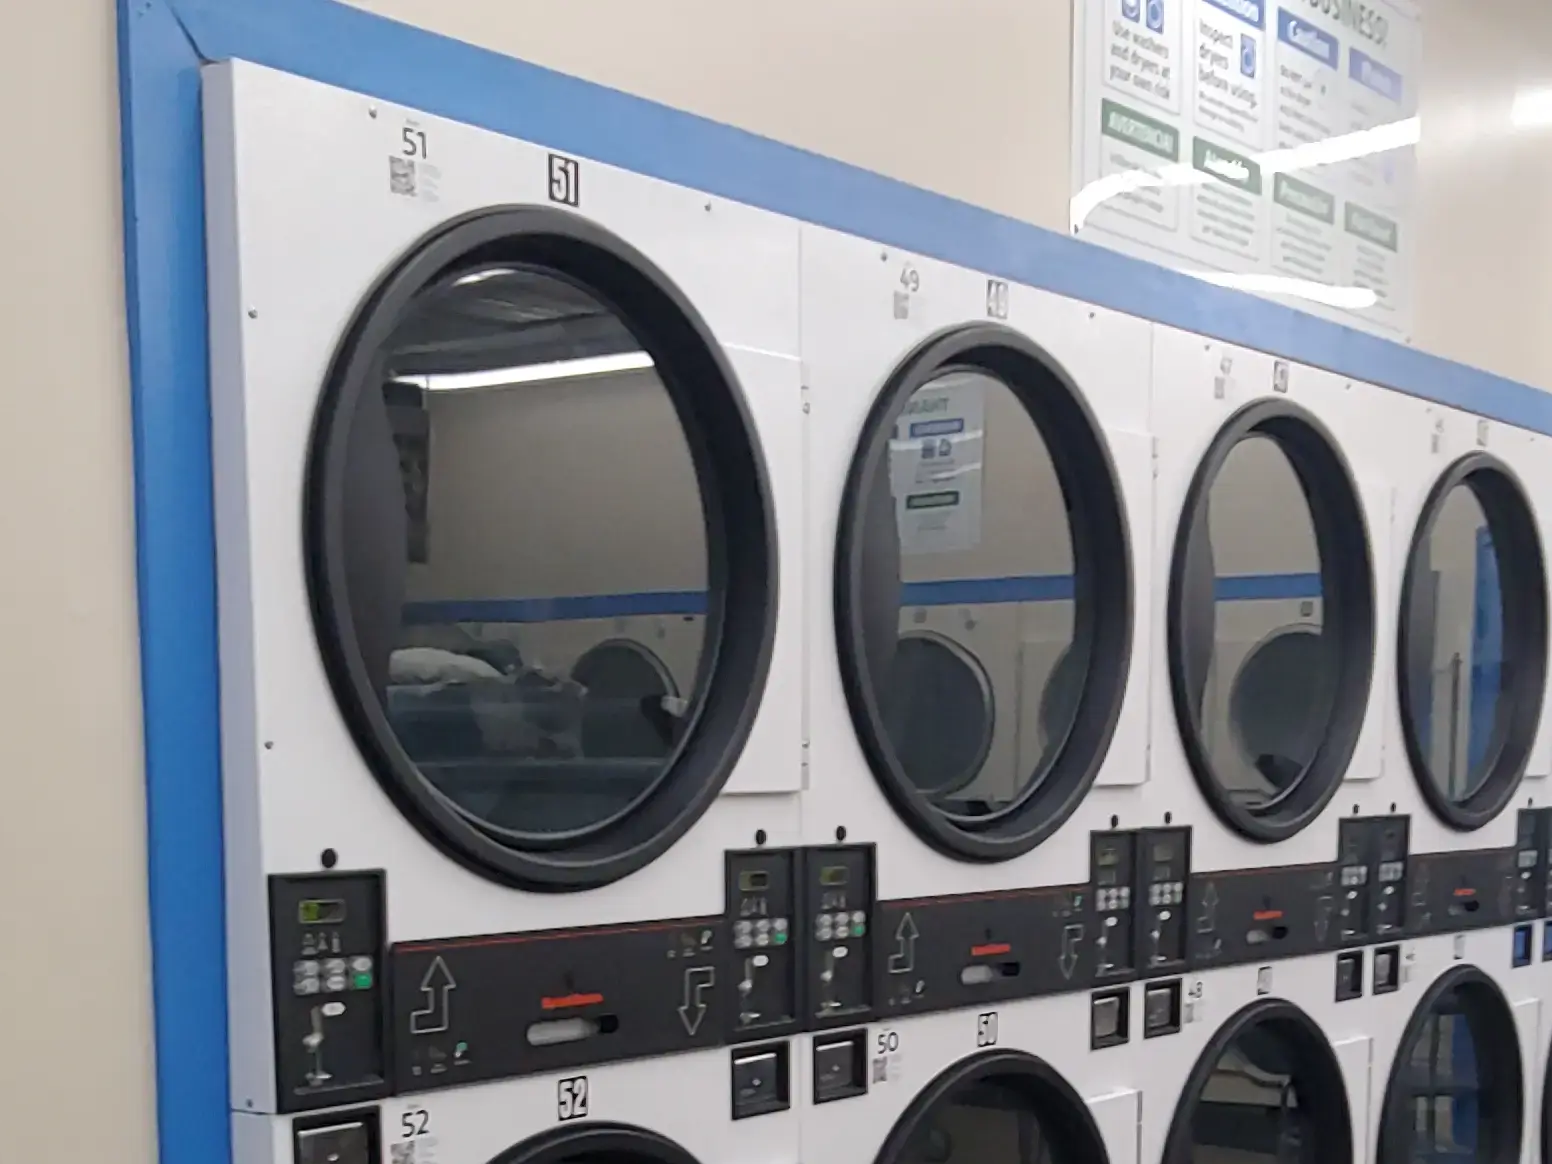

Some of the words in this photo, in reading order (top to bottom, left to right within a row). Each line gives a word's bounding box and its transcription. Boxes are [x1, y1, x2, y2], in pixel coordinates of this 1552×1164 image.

[403, 127, 427, 159] 51
[550, 154, 577, 206] 51
[900, 267, 919, 292] 49
[878, 1032, 898, 1054] 50
[558, 1076, 587, 1121] 52
[402, 1110, 429, 1138] 52
